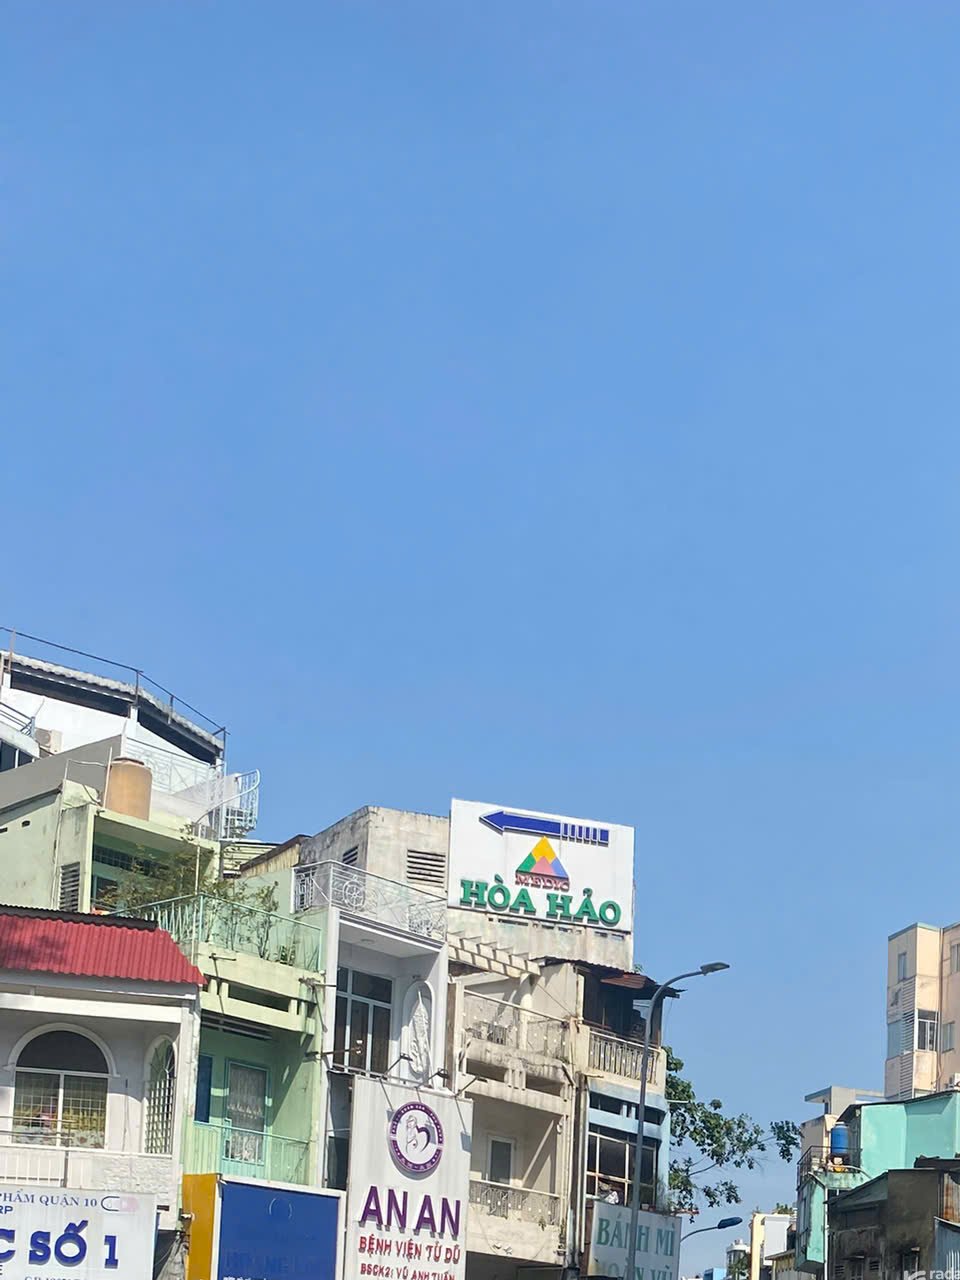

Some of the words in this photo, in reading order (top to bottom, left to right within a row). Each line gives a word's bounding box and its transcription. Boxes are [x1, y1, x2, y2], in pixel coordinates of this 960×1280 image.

[460, 874, 536, 915] HÒA
[546, 888, 621, 927] HẢO
[0, 1189, 34, 1204] HẨM
[40, 1193, 79, 1208] QUẬN
[84, 1198, 97, 1207] 10
[358, 1186, 408, 1232] AN
[413, 1194, 460, 1240] AN
[28, 1220, 88, 1267] SỐ
[103, 1235, 118, 1269] 1
[358, 1234, 392, 1259] BỆNH
[395, 1238, 422, 1261] VIỆN
[656, 1223, 675, 1256] MÌ
